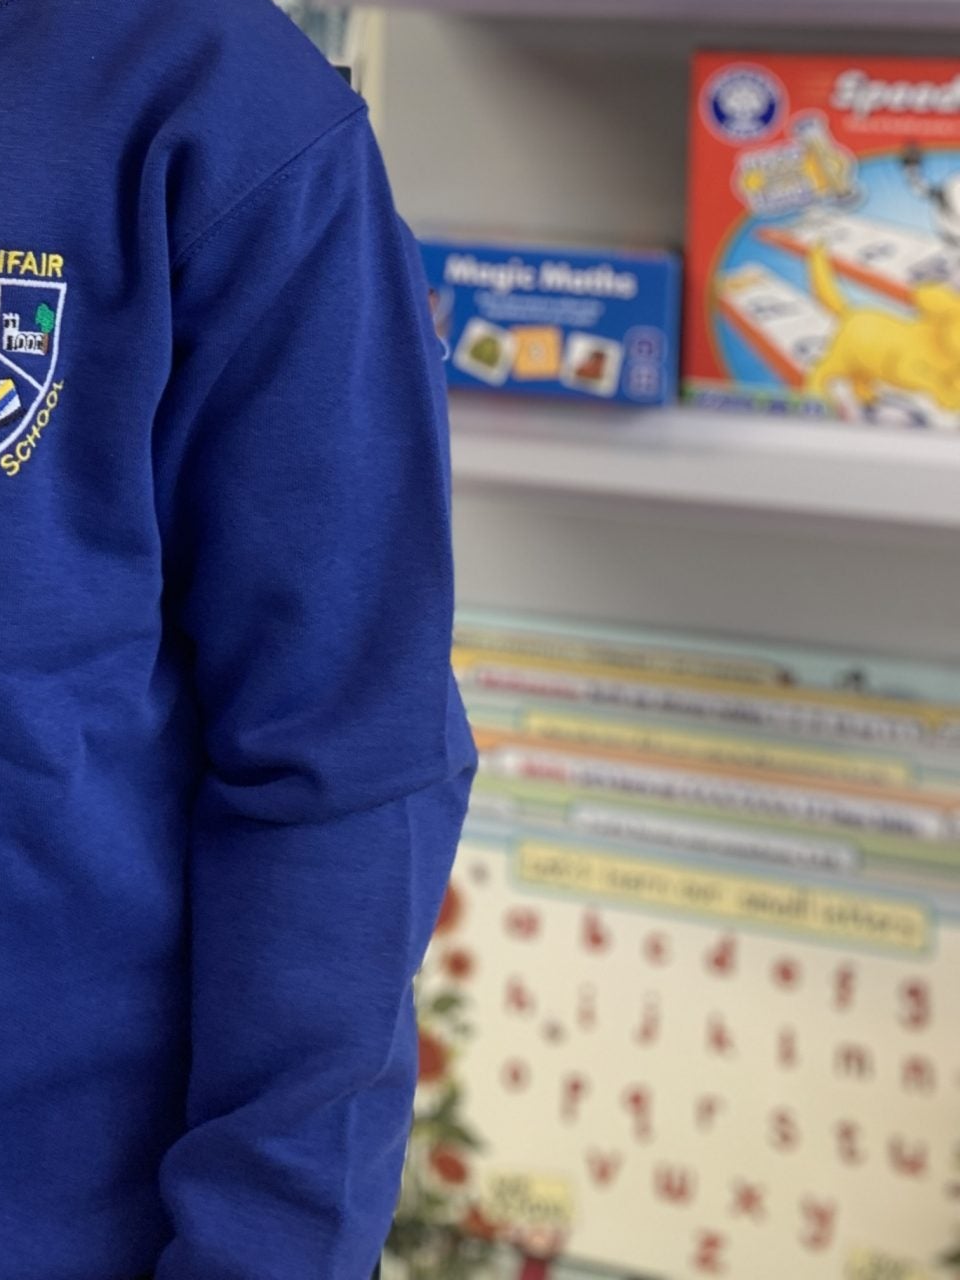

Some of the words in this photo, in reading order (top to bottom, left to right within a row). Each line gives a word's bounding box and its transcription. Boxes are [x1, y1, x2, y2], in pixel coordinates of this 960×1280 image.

[831, 70, 960, 117] Speed
[445, 255, 535, 292] Magic
[541, 261, 637, 298] Maths
[0, 380, 64, 476] SCHOOL
[739, 886, 811, 918] small
[818, 898, 918, 939] letters
[503, 908, 540, 937] a
[583, 908, 611, 954] b
[644, 934, 670, 965] c
[704, 934, 737, 976] d
[773, 959, 799, 990] e
[833, 962, 857, 1012] f
[900, 978, 929, 1031] g
[707, 1014, 735, 1057] k
[836, 1044, 871, 1080] m
[904, 1055, 933, 1094] n
[562, 1073, 589, 1122] p
[623, 1084, 651, 1142] q
[770, 1110, 798, 1152] s
[834, 1120, 864, 1164] t
[889, 1134, 929, 1177] u
[587, 1147, 622, 1185] v
[730, 1180, 765, 1218] x
[801, 1196, 835, 1252] y
[692, 1230, 727, 1274] z
